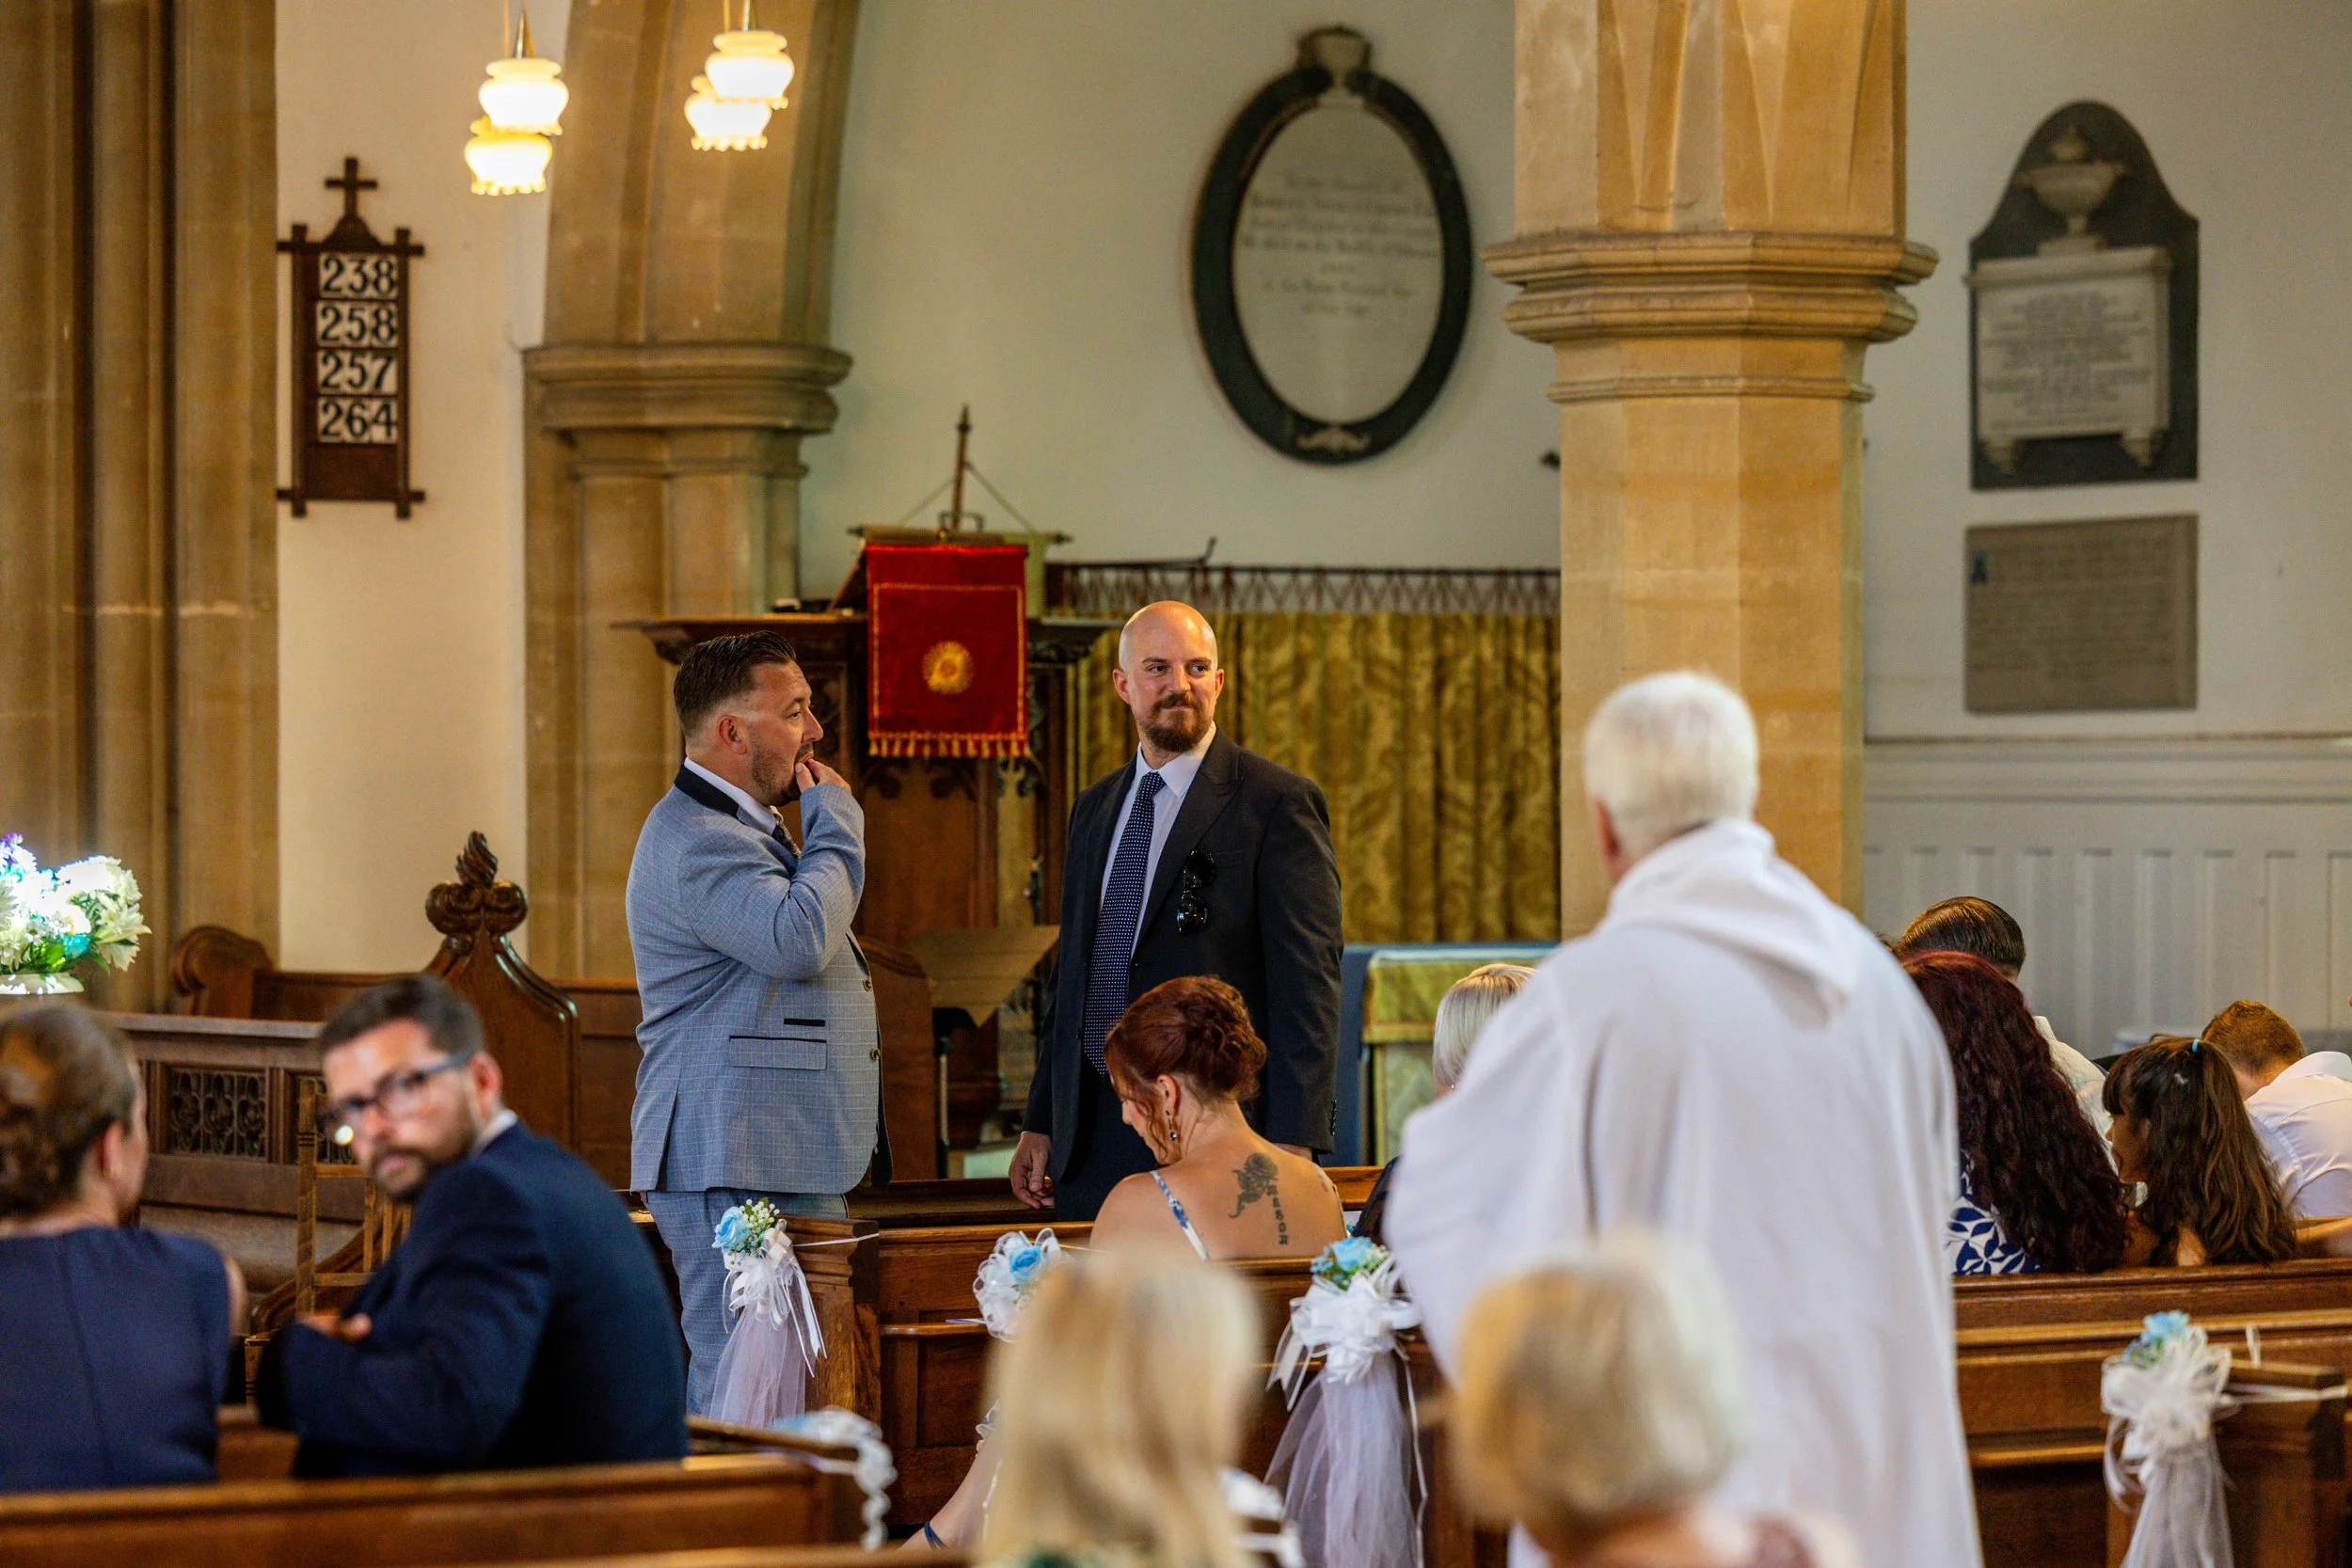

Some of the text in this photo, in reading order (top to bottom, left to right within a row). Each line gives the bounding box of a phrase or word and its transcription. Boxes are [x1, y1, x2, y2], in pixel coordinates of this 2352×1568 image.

[322, 258, 395, 294] 238
[321, 306, 396, 342] 258
[321, 351, 394, 390] 257
[321, 403, 396, 437] 264
